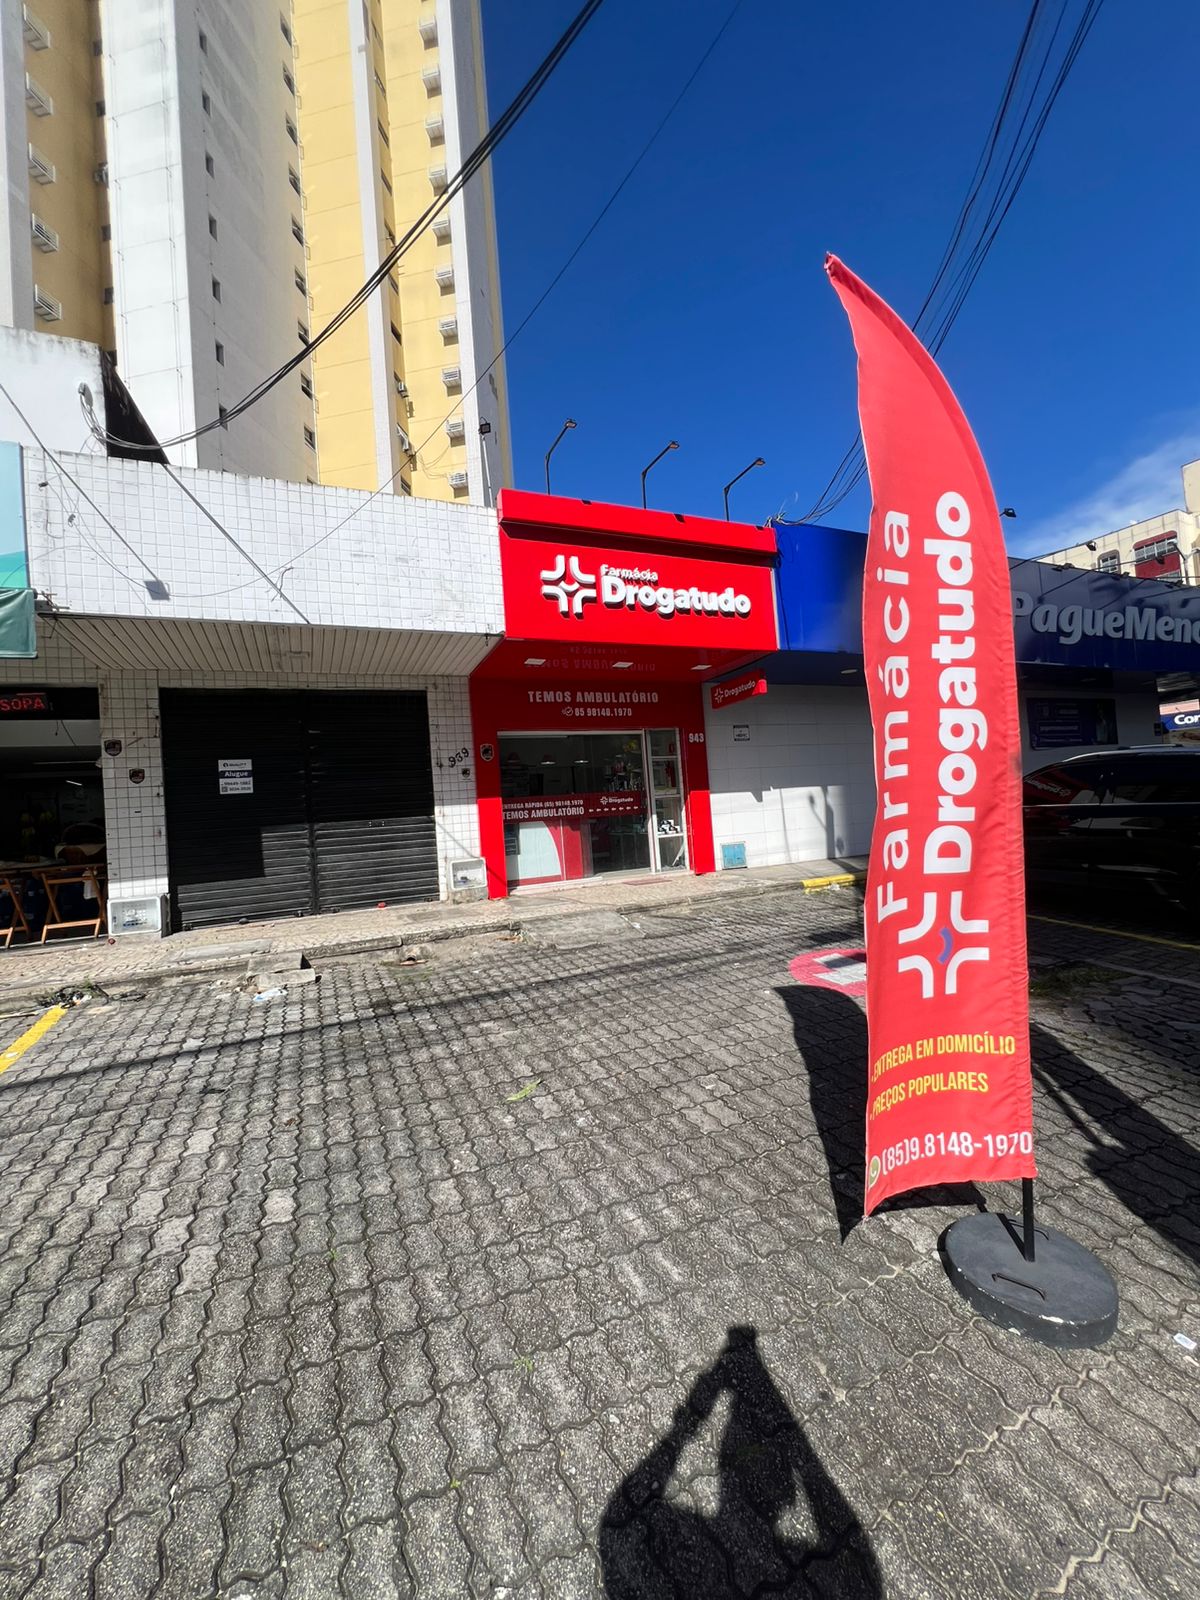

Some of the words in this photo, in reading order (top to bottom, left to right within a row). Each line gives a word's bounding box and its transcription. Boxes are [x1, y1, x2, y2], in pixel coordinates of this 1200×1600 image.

[600, 564, 659, 582] Farmácia
[601, 575, 751, 615] Drogatudo
[724, 680, 756, 697] Drogatudo
[923, 491, 988, 876] Drogatudo
[528, 691, 571, 703] TEMOS
[576, 690, 659, 703] AMBULATÓRIO
[877, 510, 909, 924] Farmácia
[688, 733, 704, 743] 943
[448, 747, 469, 768] 939
[531, 806, 585, 818] AMBULATÓRIO
[916, 1038, 934, 1059] EM
[937, 1031, 1015, 1055] DOMICÍLIO
[908, 1071, 989, 1098] POPULARES
